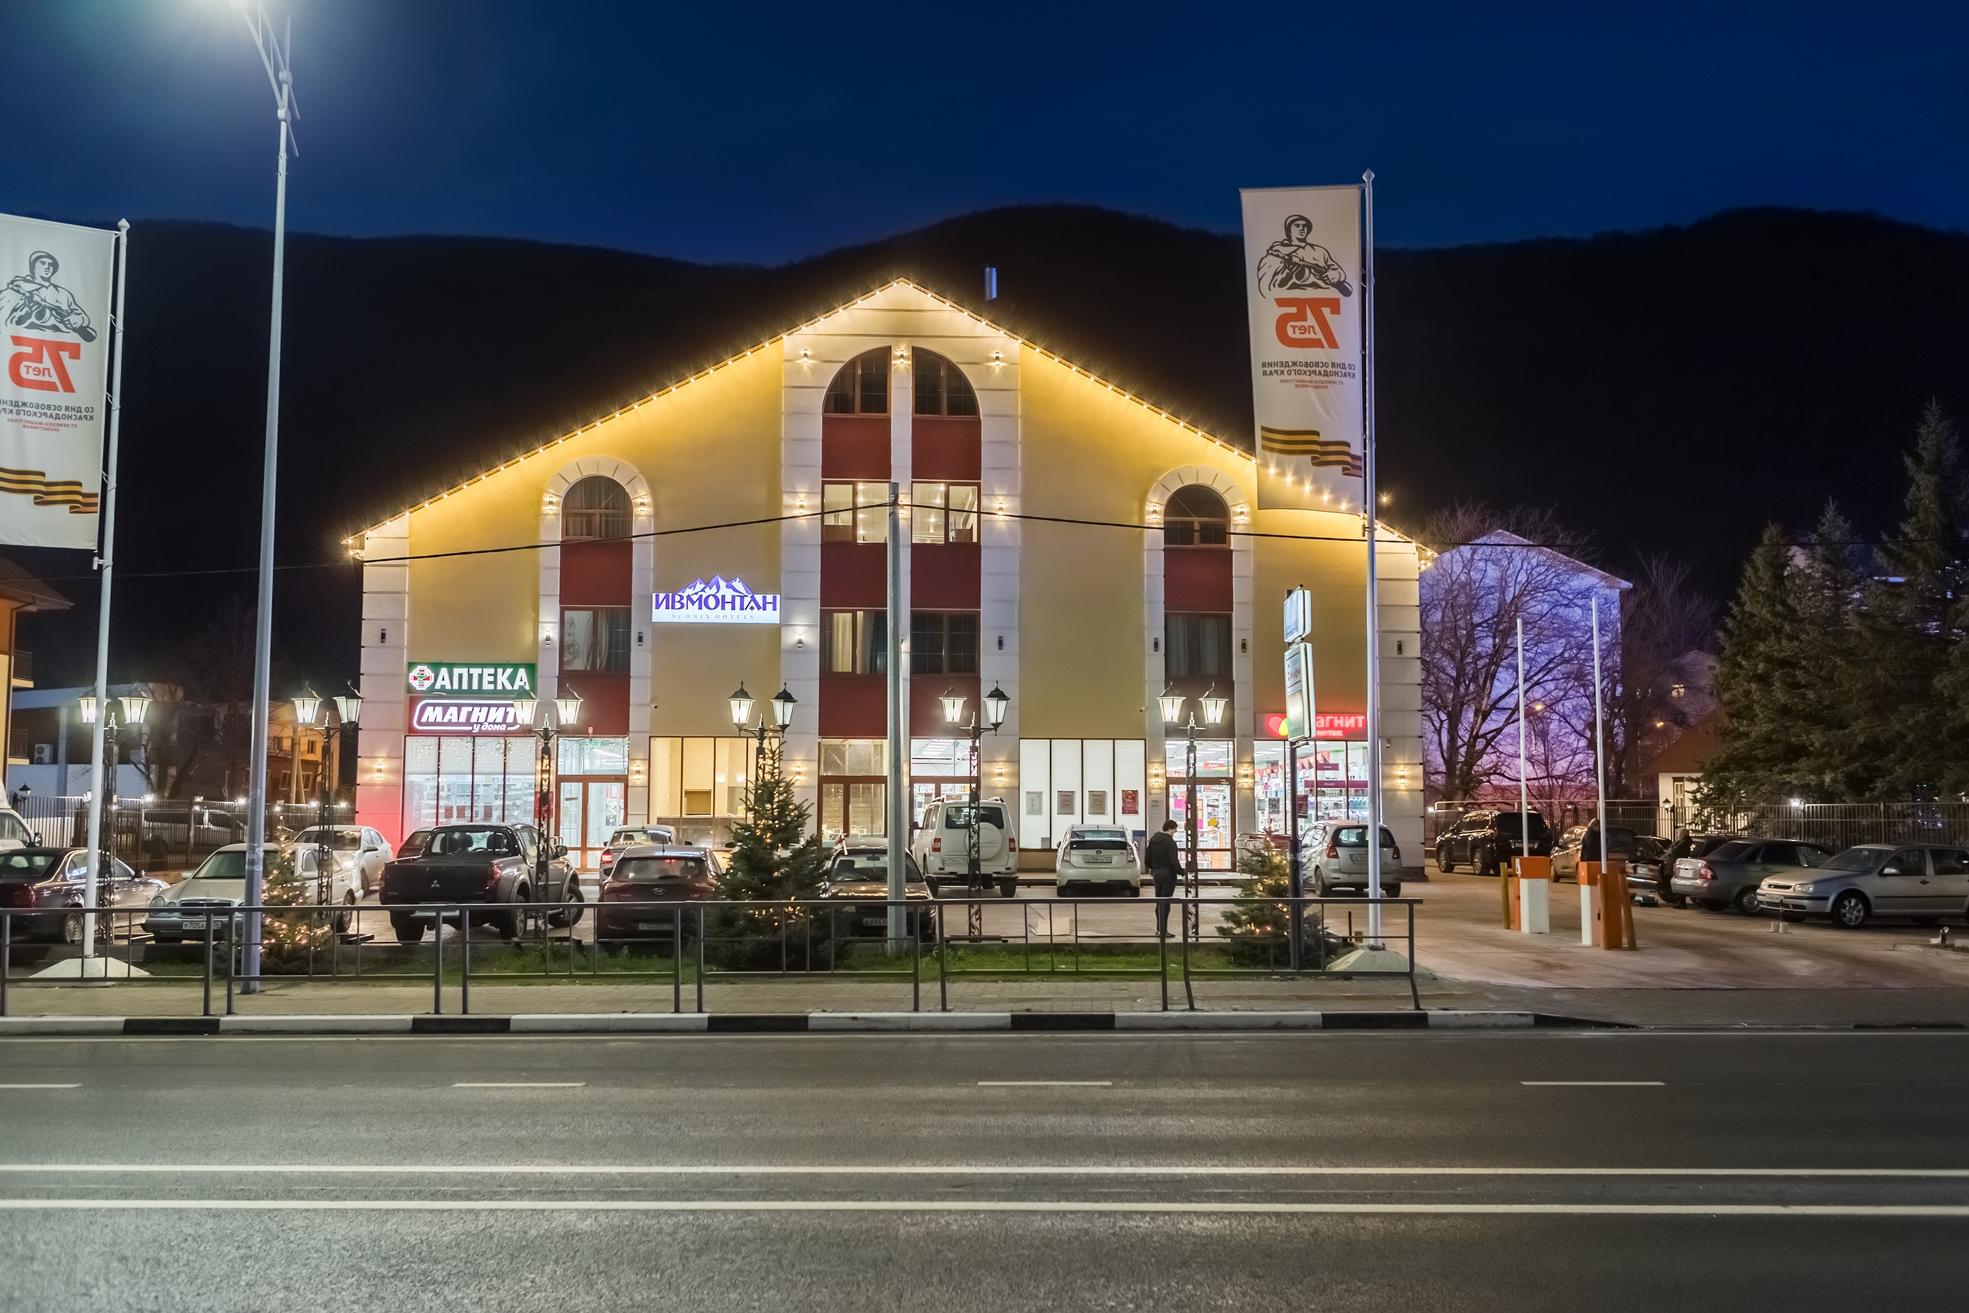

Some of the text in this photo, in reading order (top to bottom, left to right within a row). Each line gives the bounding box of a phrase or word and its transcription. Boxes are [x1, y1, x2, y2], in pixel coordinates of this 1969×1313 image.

[654, 593, 777, 611] ИВМОНТАН
[434, 667, 531, 690] АПТЕКА
[420, 706, 516, 723] МАГНИТ
[1316, 715, 1366, 728] агнит
[472, 722, 508, 733] у дома
